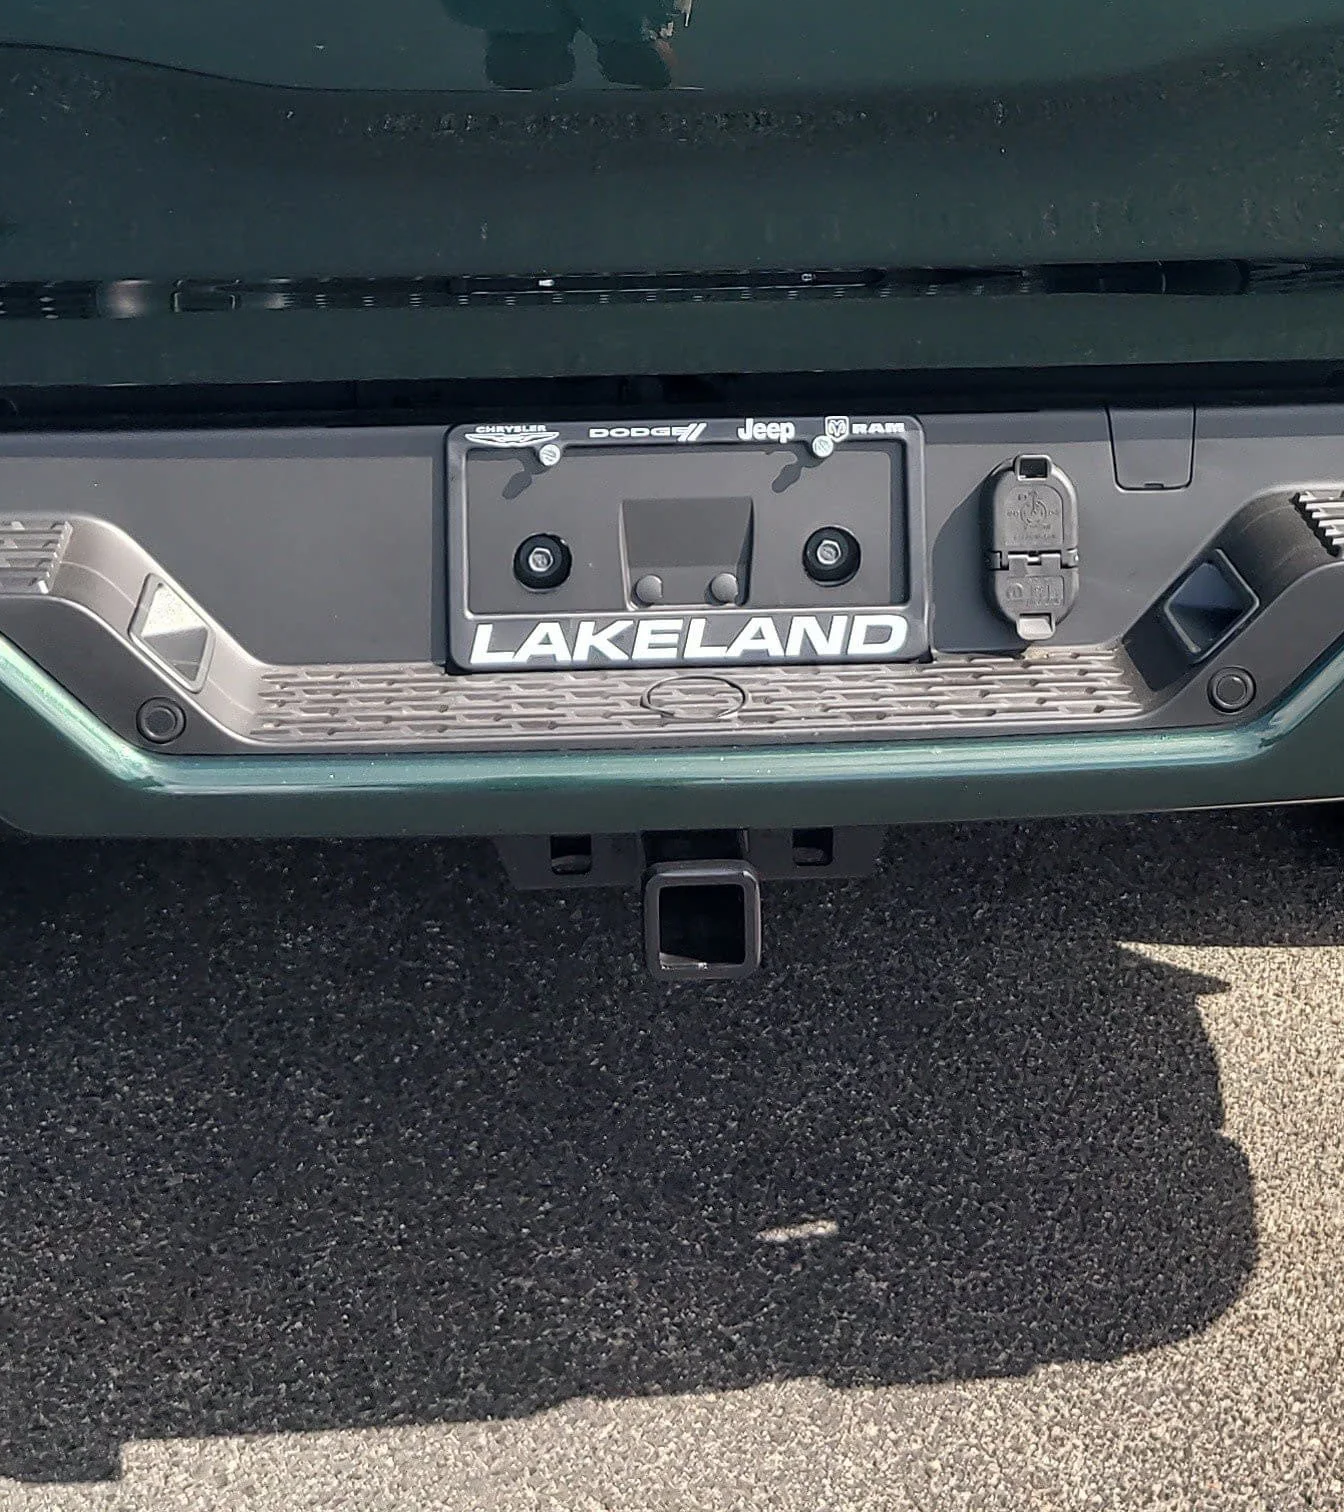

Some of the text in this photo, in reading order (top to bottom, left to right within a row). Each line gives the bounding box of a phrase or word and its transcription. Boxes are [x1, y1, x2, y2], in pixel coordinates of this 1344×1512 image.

[475, 424, 547, 434] CHRYSLER
[589, 426, 690, 439] DODGE
[737, 418, 795, 444] Jeep
[852, 423, 905, 435] RAM
[470, 614, 908, 665] LAKELAND
